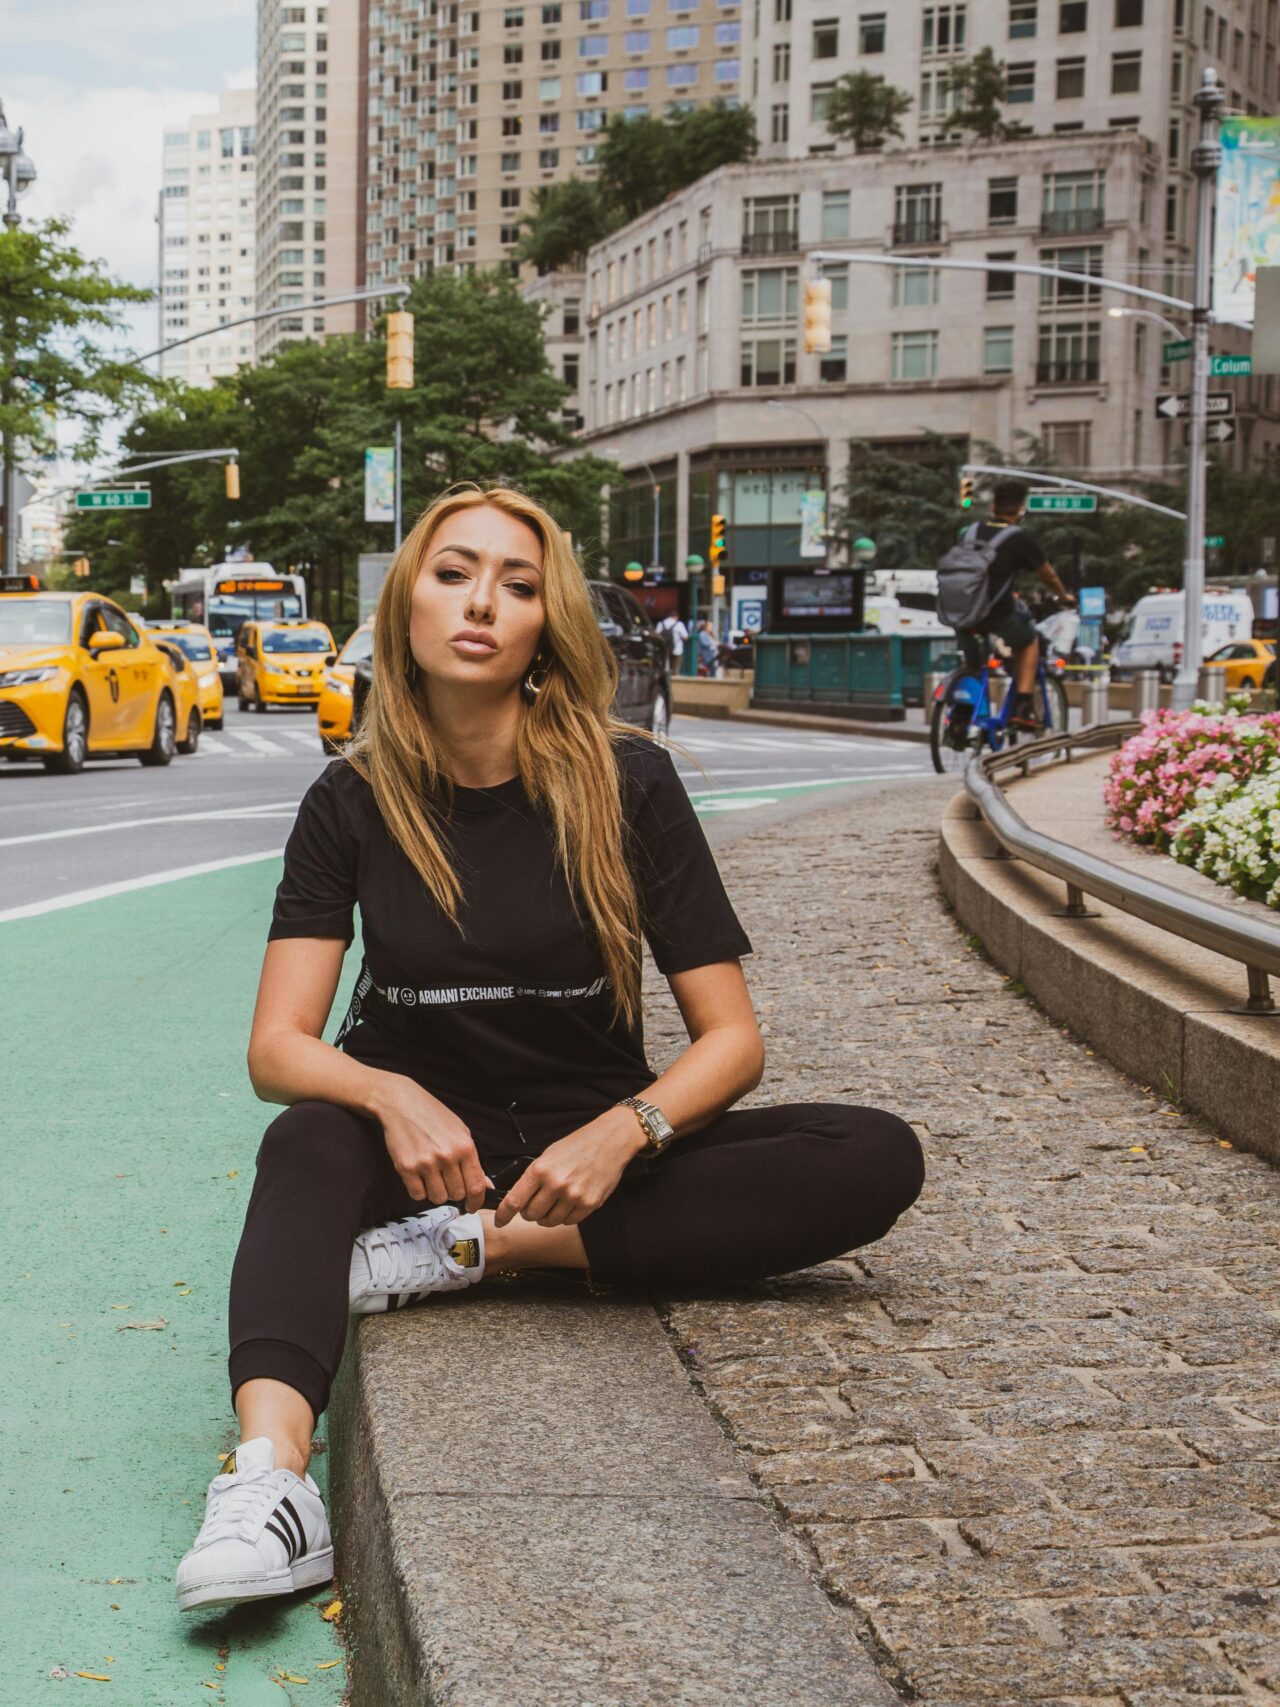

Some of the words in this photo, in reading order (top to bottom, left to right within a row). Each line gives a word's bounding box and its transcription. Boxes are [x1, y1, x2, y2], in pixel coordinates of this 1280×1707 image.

[92, 495, 102, 505] W
[387, 986, 399, 1005] AX
[419, 988, 458, 1004] ARMANI
[459, 986, 515, 1002] EXCHANGE
